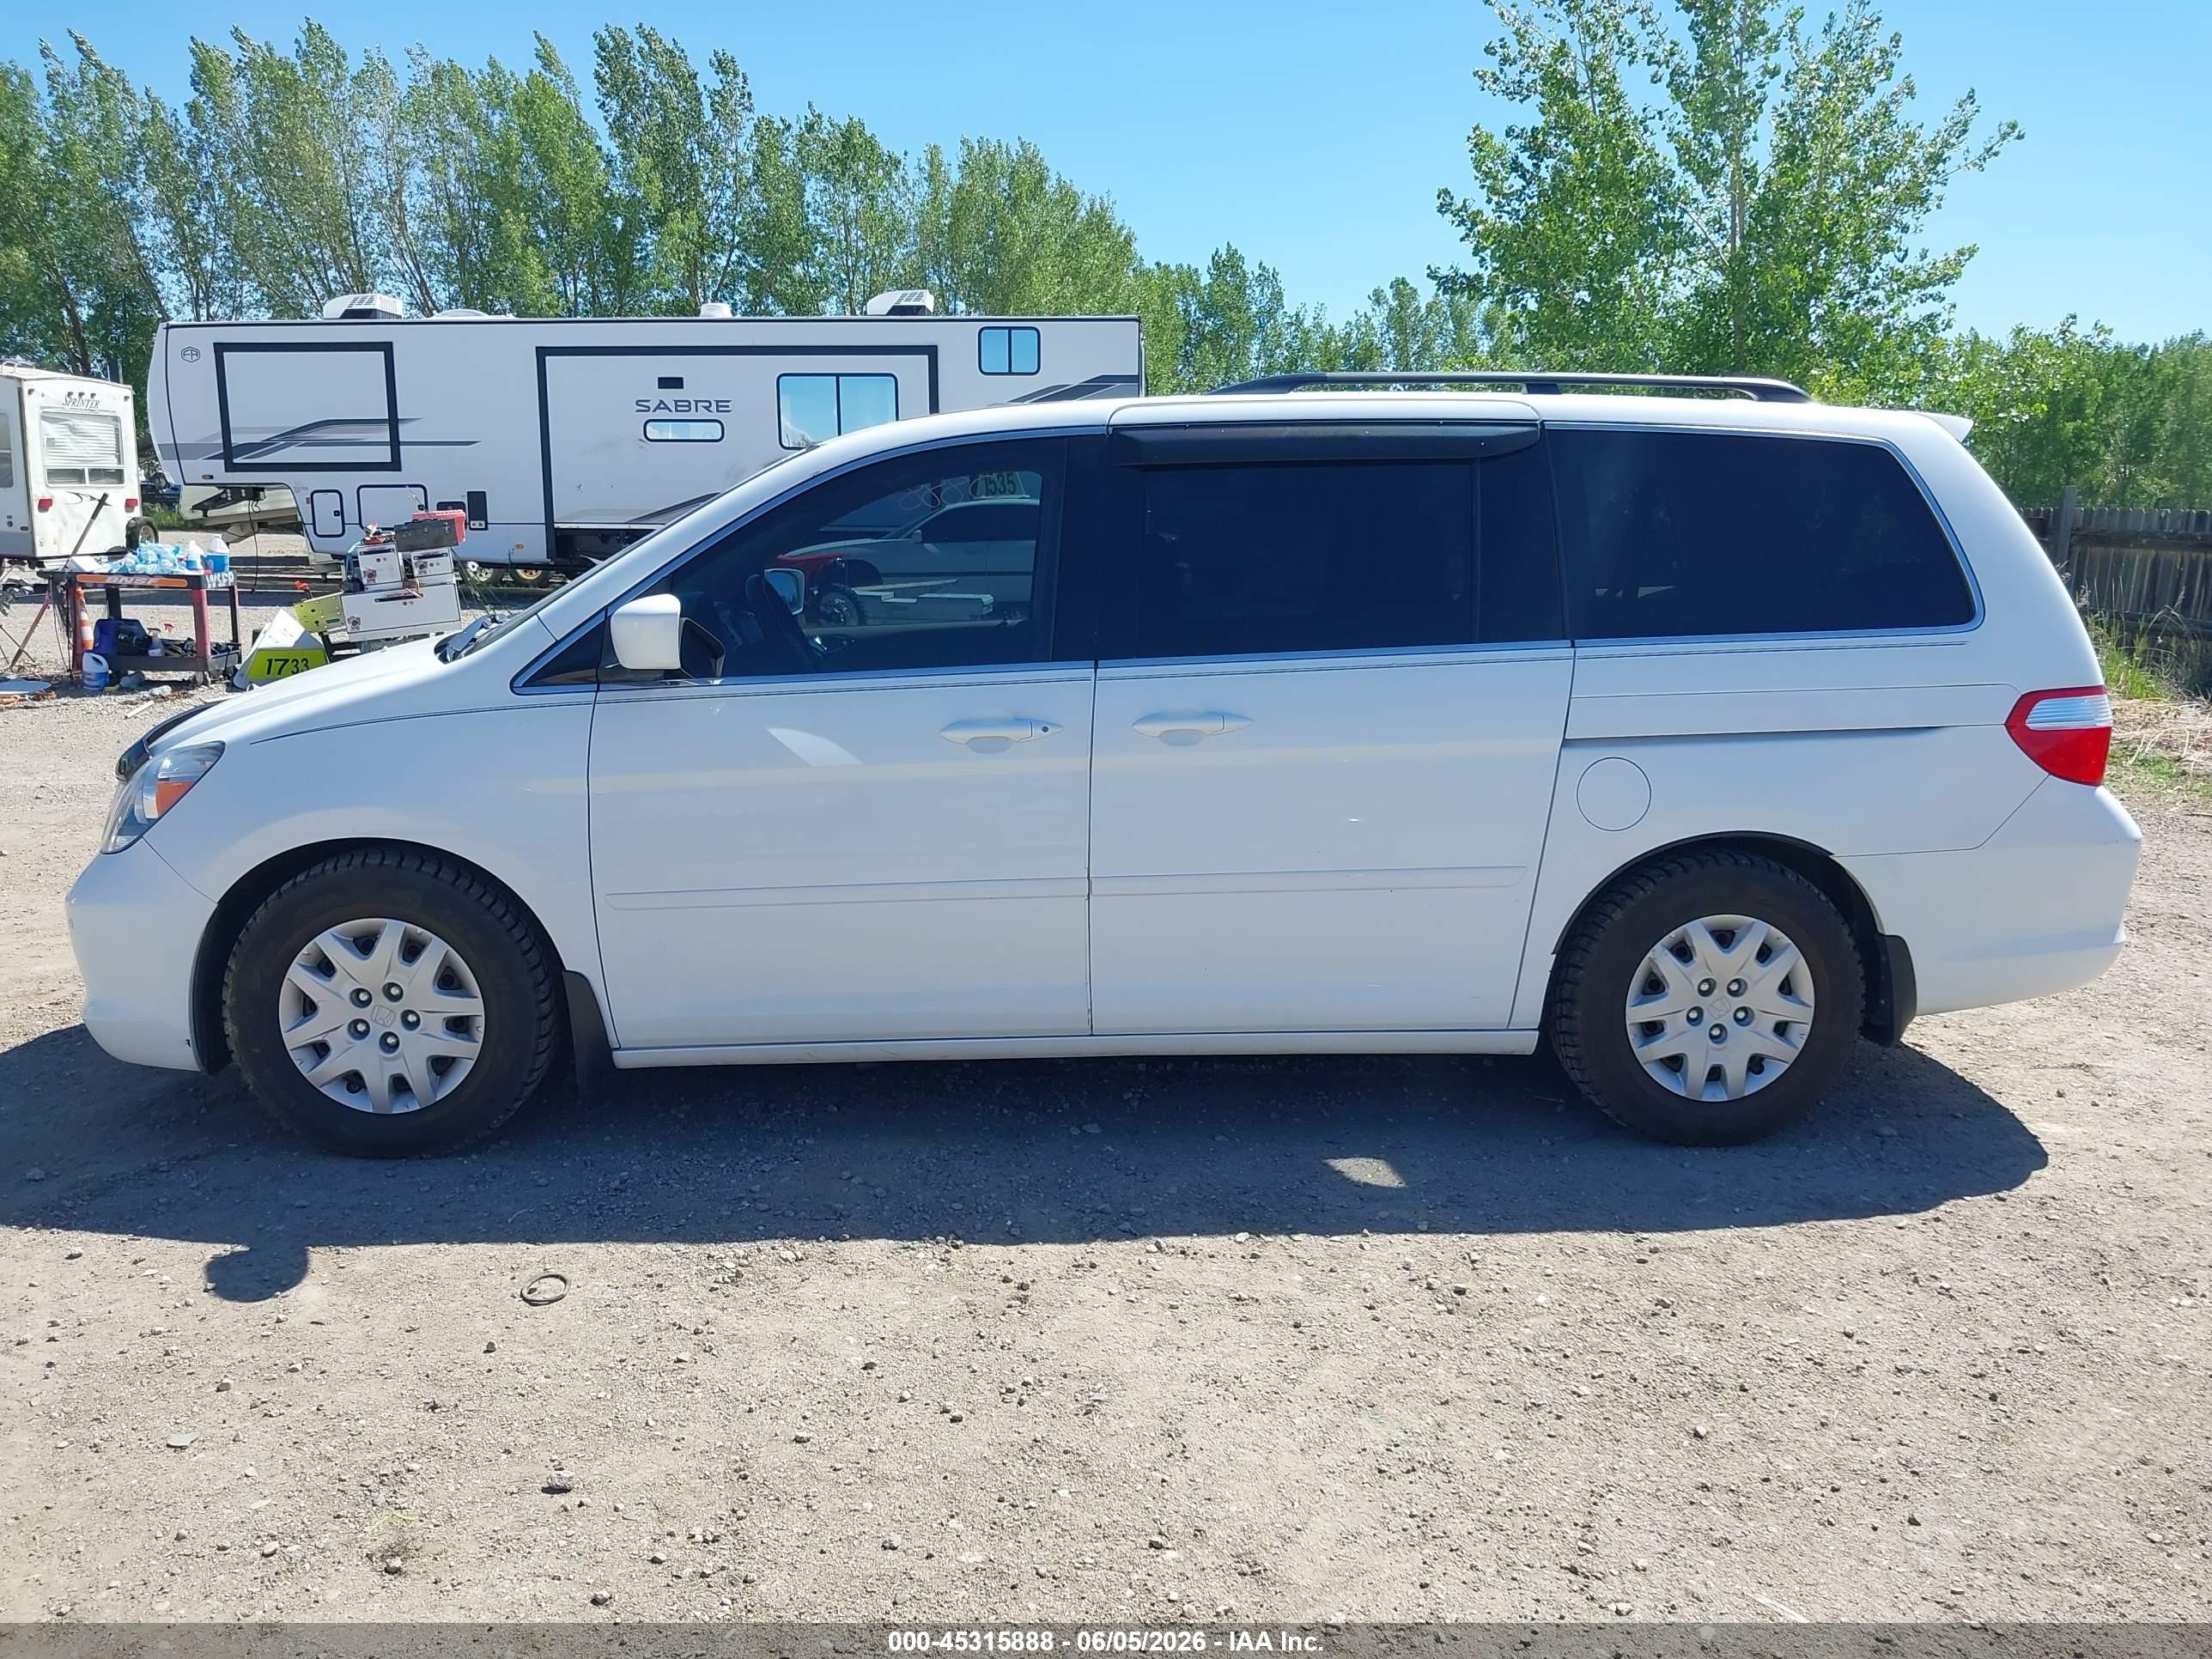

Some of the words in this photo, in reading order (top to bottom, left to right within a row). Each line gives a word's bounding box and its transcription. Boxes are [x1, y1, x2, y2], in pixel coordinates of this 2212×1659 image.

[63, 394, 100, 409] SPRINTER
[635, 398, 733, 413] SABRE
[984, 473, 1017, 496] 1535
[104, 574, 160, 586] BNSF
[266, 658, 310, 676] 1733
